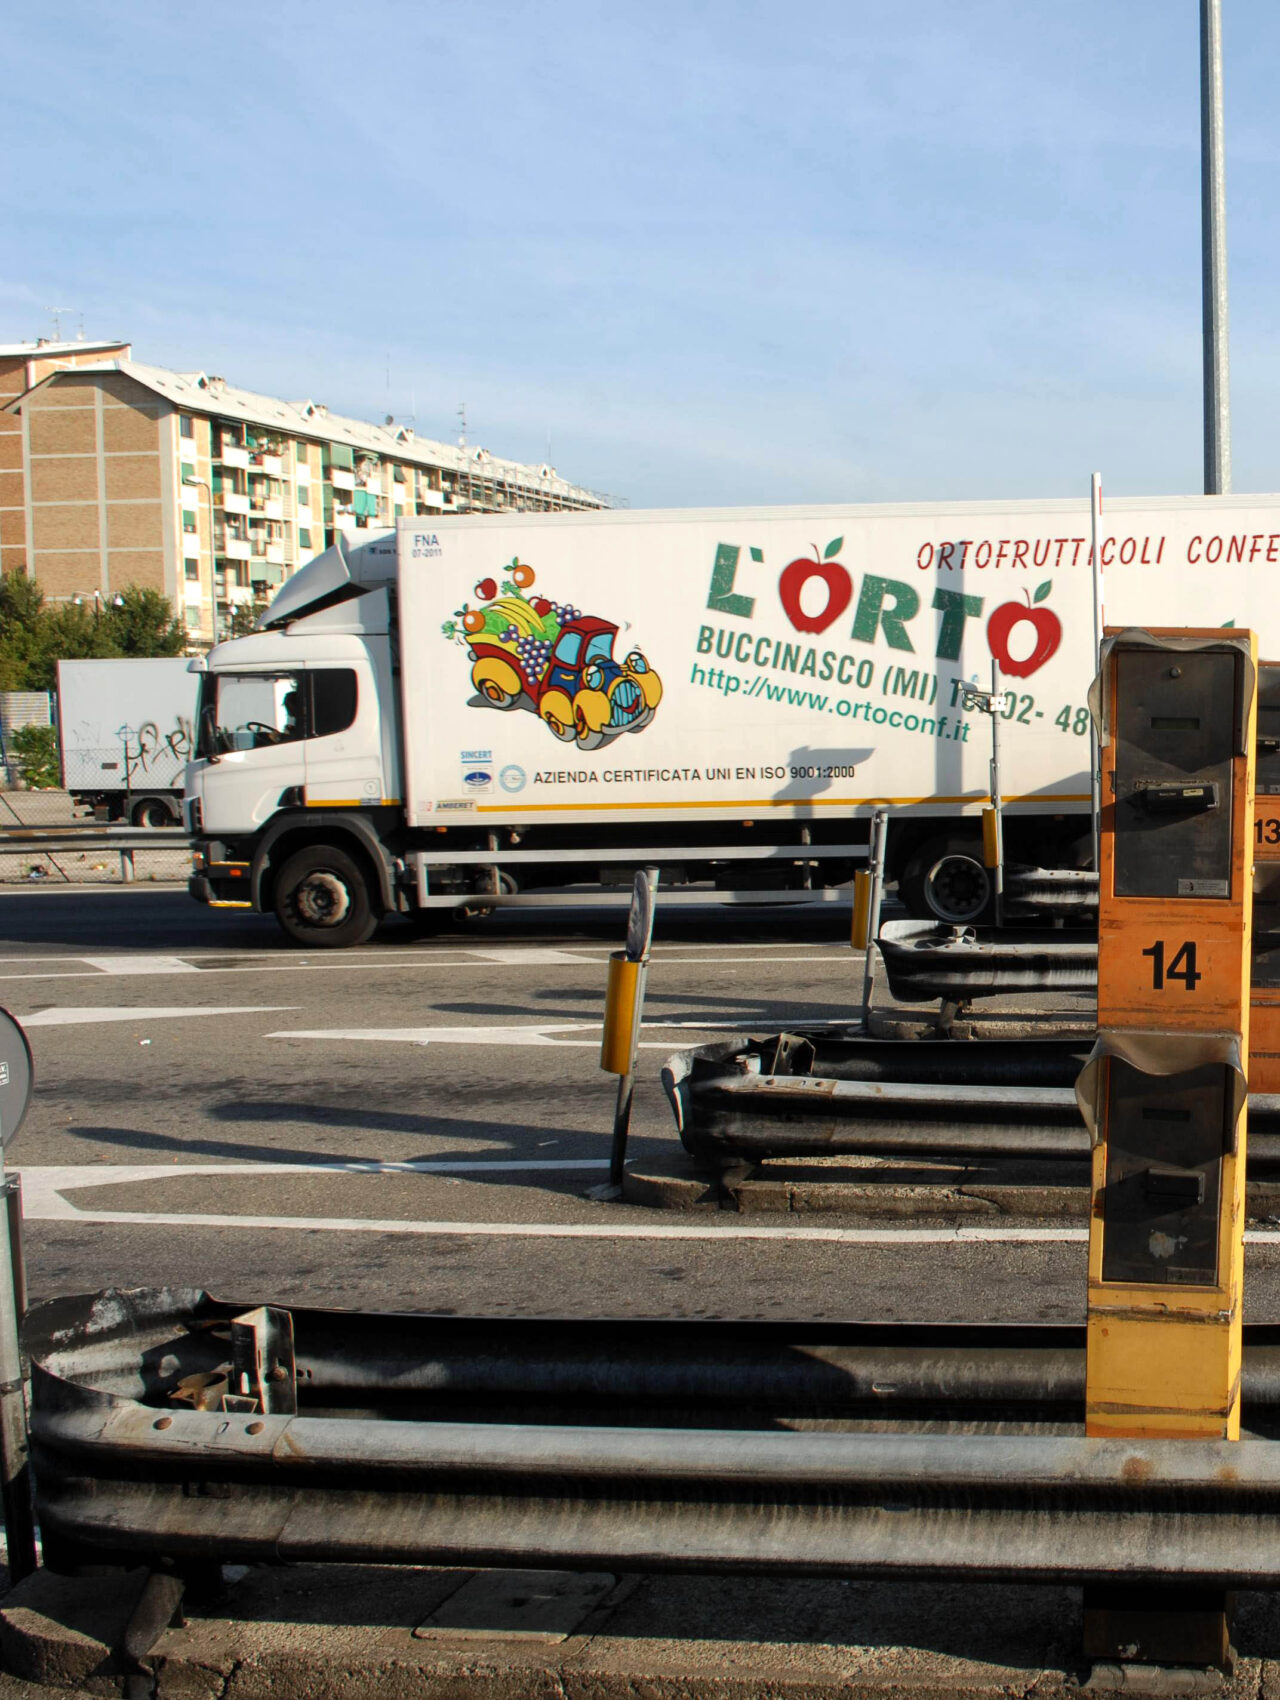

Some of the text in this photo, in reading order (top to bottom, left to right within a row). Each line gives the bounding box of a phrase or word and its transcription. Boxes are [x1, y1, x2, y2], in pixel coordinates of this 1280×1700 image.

[412, 548, 442, 558] 07-2011
[414, 534, 439, 546] FNA
[917, 536, 1165, 571] ORTOFRUTTICOLI
[696, 625, 875, 690] BUCCINASCO
[881, 664, 938, 705] (MI)
[690, 663, 971, 744] http://www.ortoconf.it
[533, 770, 598, 784] AZIENDA
[603, 768, 701, 782] CERTIFICATA
[706, 768, 731, 780] UNI
[736, 767, 756, 779] EN
[761, 766, 786, 779] ISO
[790, 765, 855, 779] 9001:2000
[1142, 940, 1202, 991] 14
